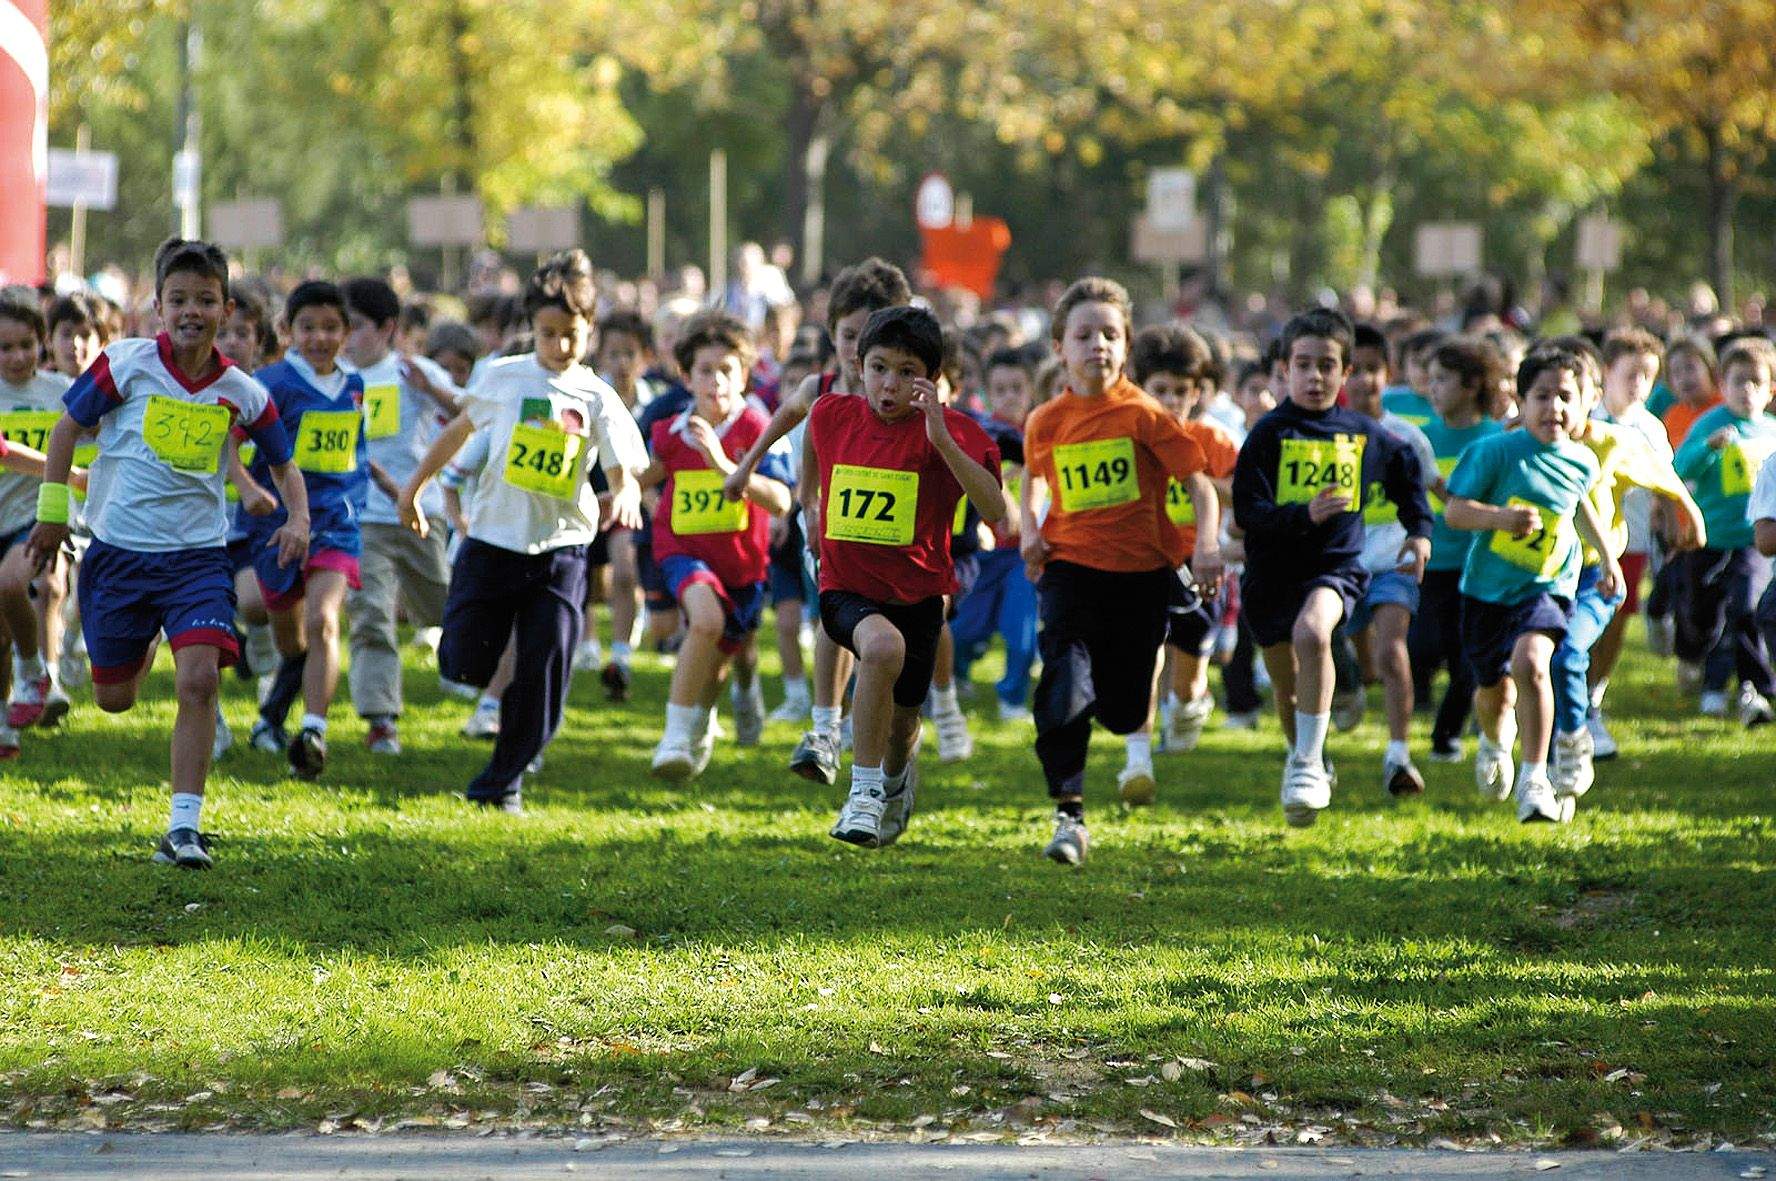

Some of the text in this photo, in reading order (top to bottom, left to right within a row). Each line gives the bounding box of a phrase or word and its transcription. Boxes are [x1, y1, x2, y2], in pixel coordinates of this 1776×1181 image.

[307, 429, 350, 452] 380
[512, 441, 576, 480] 2481
[1062, 457, 1130, 490] 1149
[1286, 460, 1354, 488] 1248
[679, 489, 725, 513] 397
[840, 488, 896, 522] 172
